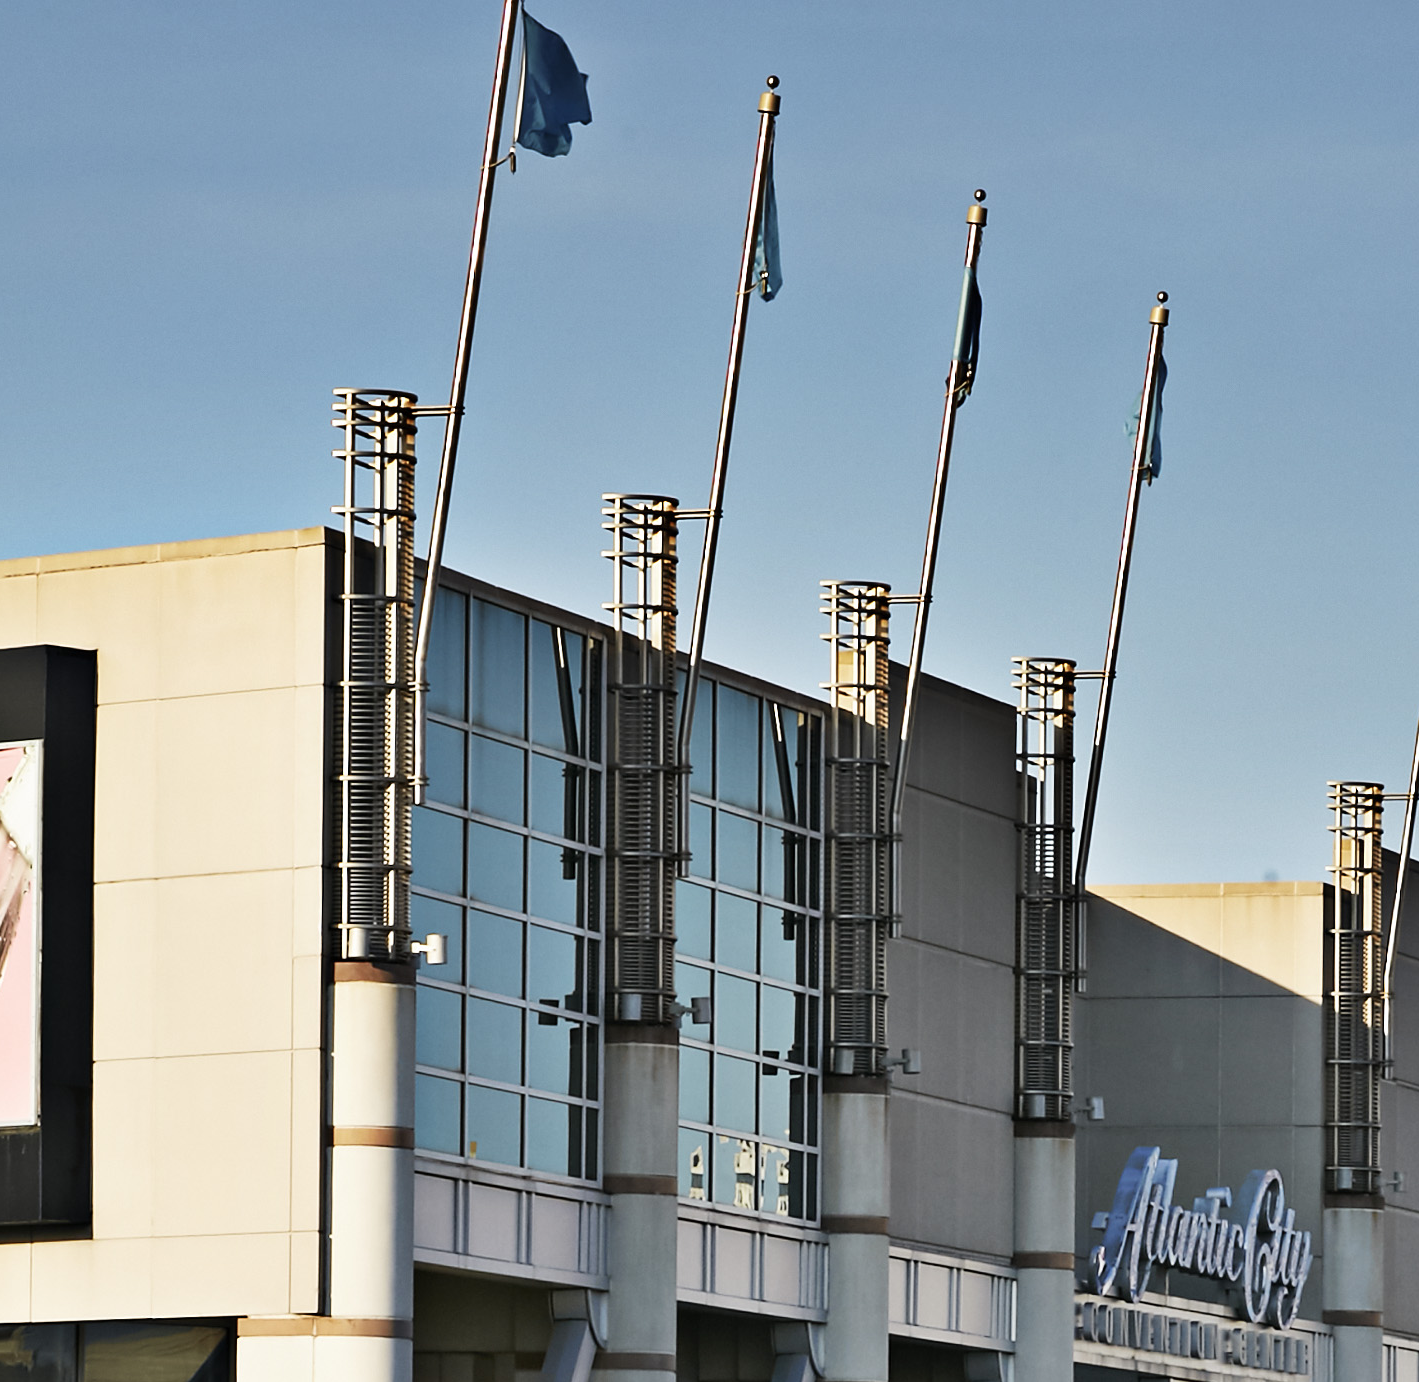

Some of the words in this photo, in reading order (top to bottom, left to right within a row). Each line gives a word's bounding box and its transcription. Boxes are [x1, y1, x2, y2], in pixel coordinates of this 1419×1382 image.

[1089, 1147, 1246, 1304] Atlantic
[1240, 1169, 1313, 1330] City
[1083, 1301, 1218, 1361] CONVENTION
[1230, 1327, 1309, 1375] CENTER
